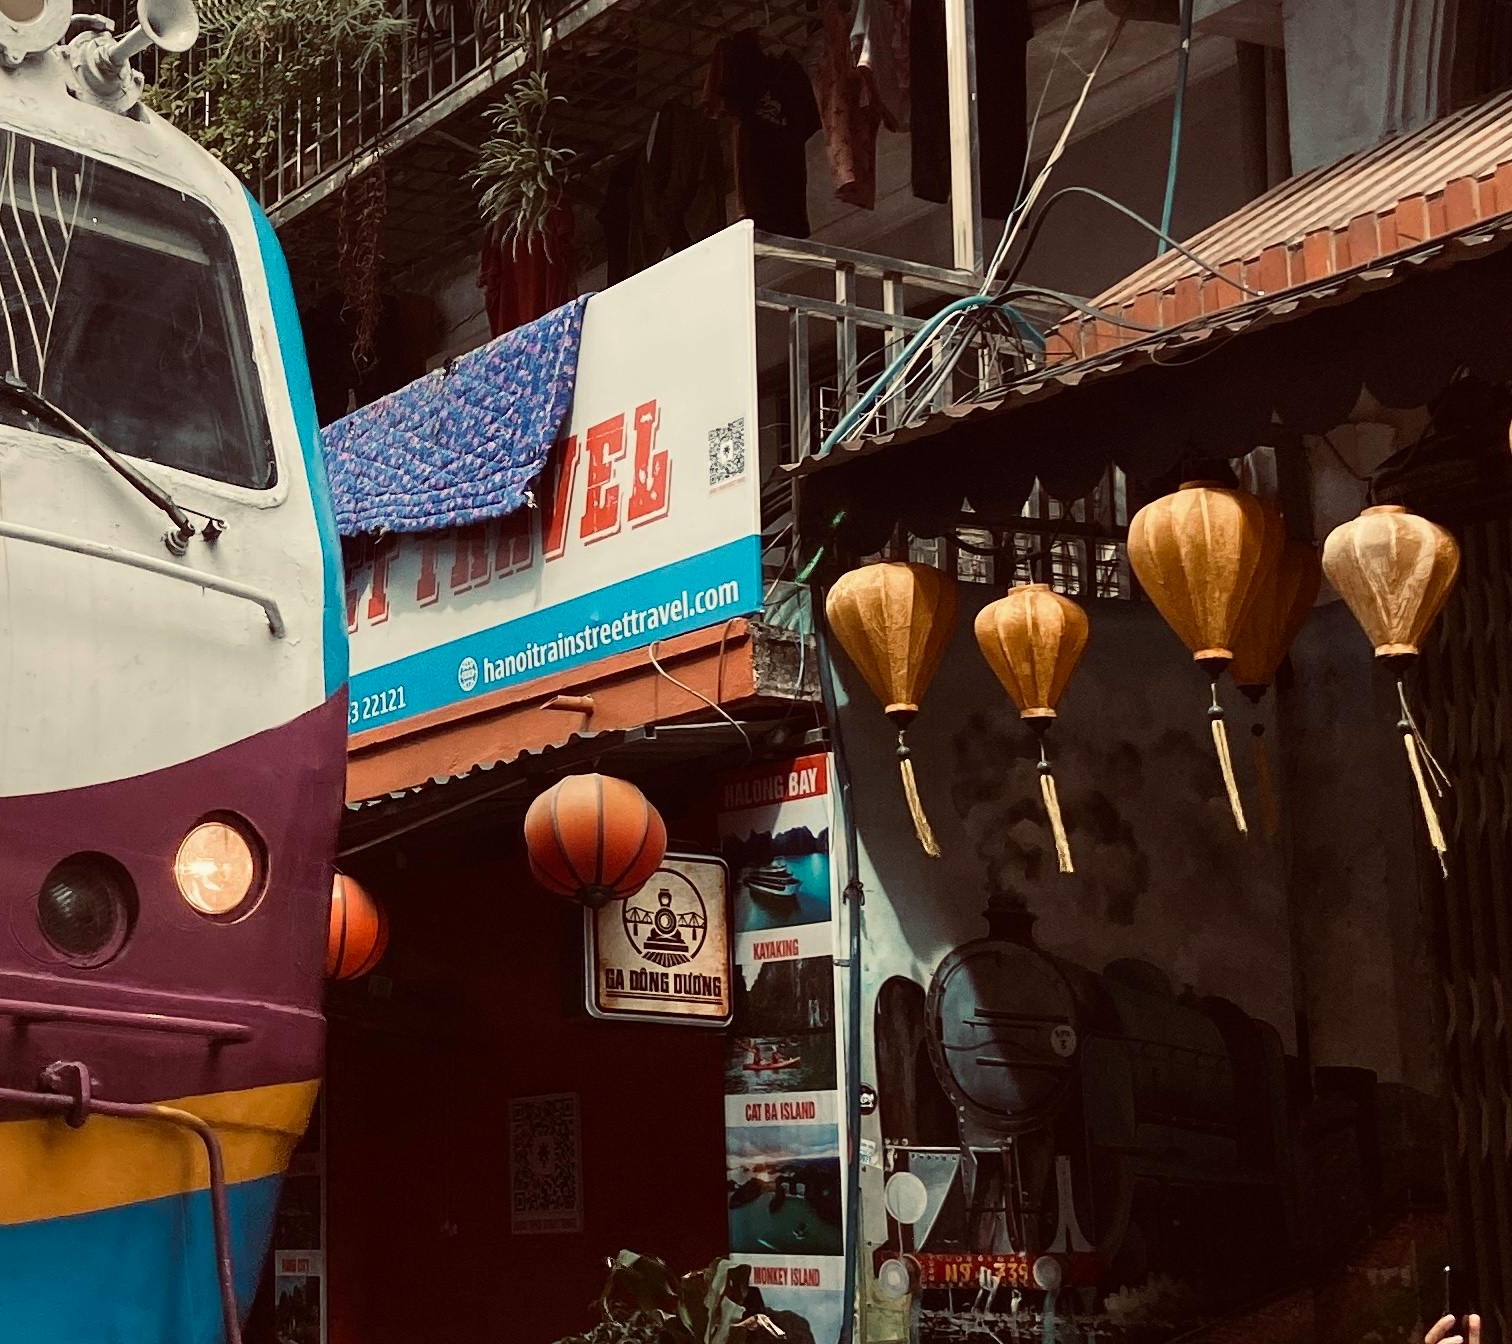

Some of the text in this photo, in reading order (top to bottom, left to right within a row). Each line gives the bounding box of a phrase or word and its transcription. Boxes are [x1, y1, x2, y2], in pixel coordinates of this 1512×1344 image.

[483, 579, 740, 684] hanoitrainstreettravel.com
[361, 686, 407, 718] 22121
[723, 768, 819, 808] HALONG BAY
[753, 938, 799, 961] KAYAKING
[605, 968, 625, 990] GA
[673, 972, 722, 998] DƯƠNG
[745, 1101, 816, 1122] CAT BA ISLAND
[753, 1266, 821, 1287] MONKEY ISLAND
